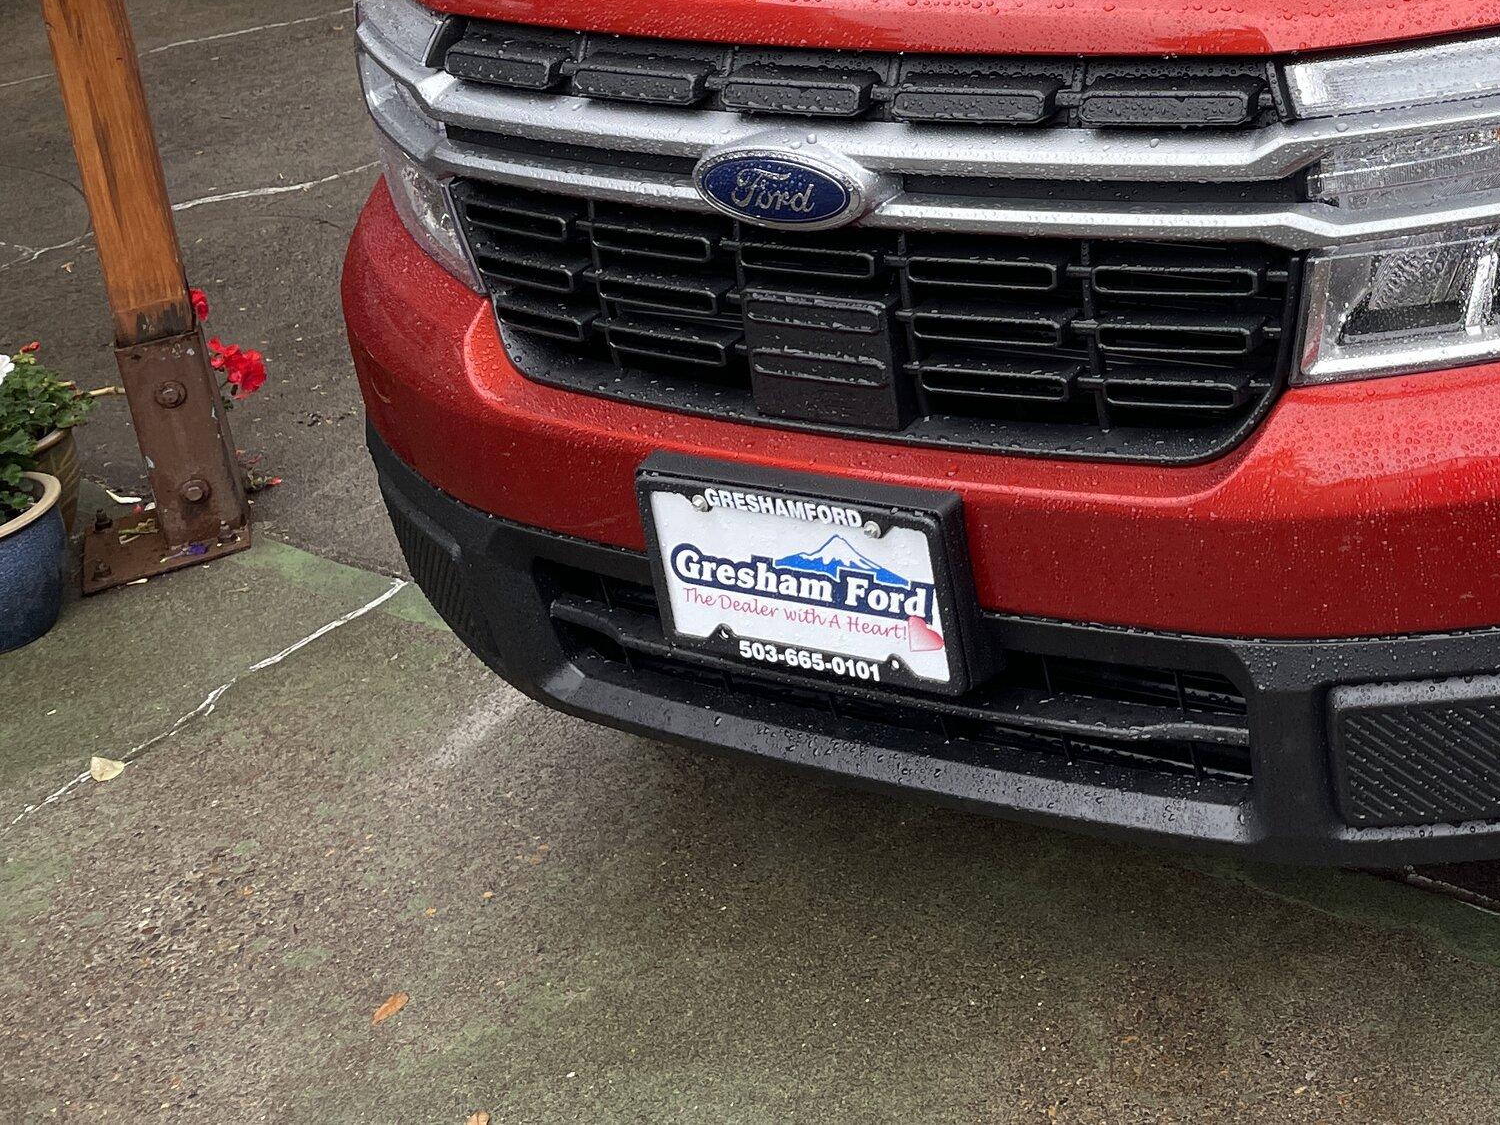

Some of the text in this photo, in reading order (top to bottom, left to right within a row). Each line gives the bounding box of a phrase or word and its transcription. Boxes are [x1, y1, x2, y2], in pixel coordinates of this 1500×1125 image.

[731, 168, 815, 213] Ford
[704, 488, 862, 528] GRESHAMFORD
[675, 549, 927, 617] Gresham Ford
[683, 587, 908, 640] The Dealer with A Heart!
[738, 640, 881, 682] 503-665-0101
